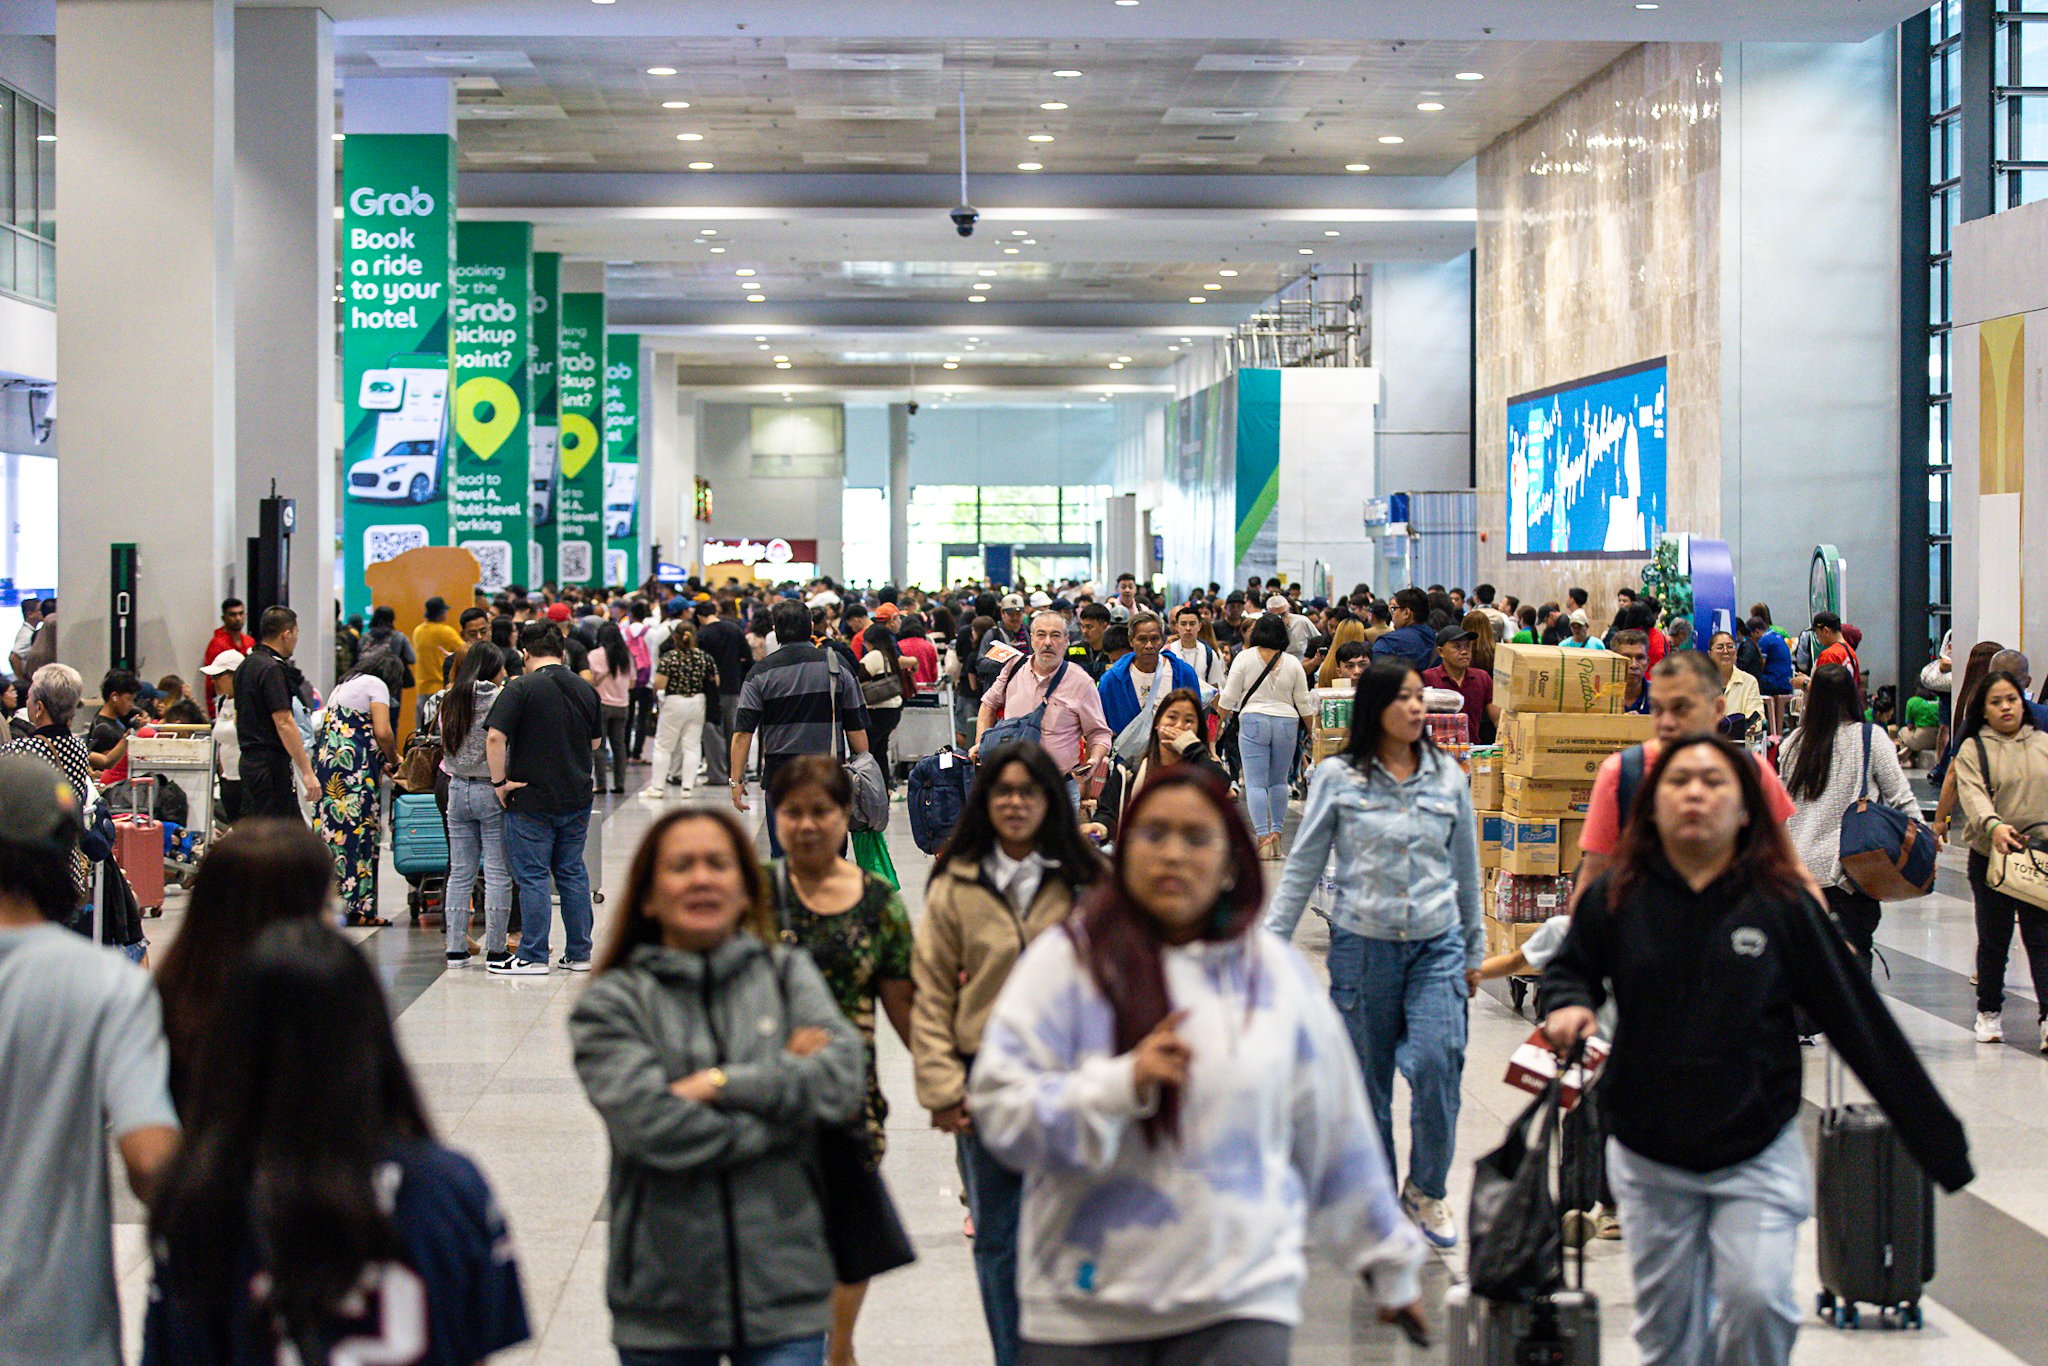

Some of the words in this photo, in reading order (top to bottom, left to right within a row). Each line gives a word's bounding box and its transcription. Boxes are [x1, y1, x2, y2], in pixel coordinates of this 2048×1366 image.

[350, 185, 435, 217] Grab
[351, 227, 416, 249] Book
[350, 259, 369, 276] a
[372, 253, 423, 276] ride
[456, 265, 506, 280] ooking
[350, 280, 379, 300] to
[382, 282, 442, 305] your
[472, 282, 497, 294] the
[351, 306, 419, 329] hotel
[456, 472, 485, 486] ead
[486, 475, 502, 486] to
[456, 487, 485, 501] evel
[456, 518, 502, 534] arking
[2014, 862, 2039, 877] TOTE
